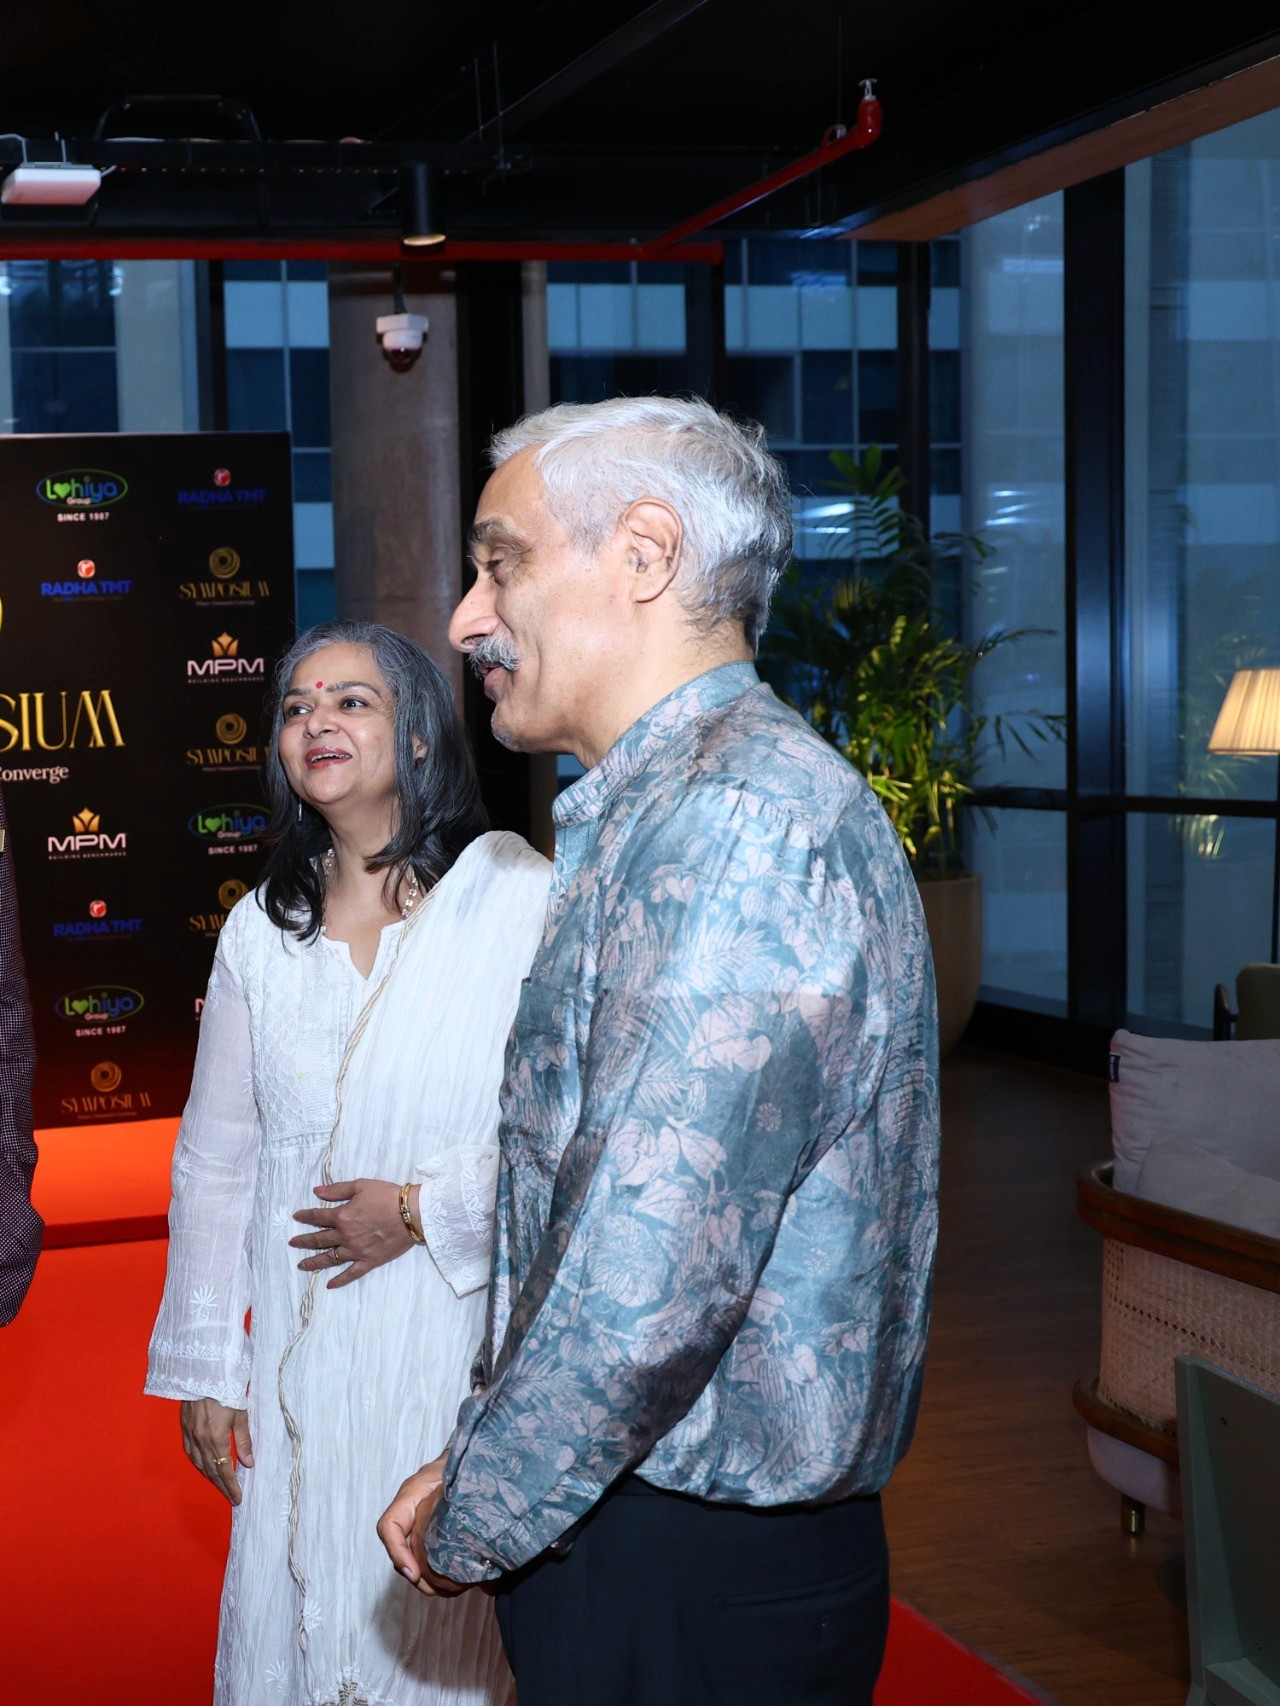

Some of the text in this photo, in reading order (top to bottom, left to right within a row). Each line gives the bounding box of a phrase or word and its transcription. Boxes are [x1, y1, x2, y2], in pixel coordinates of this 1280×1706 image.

[177, 489, 266, 503] RADHA TMT
[57, 512, 110, 522] SINCE 1987
[41, 580, 132, 596] RADHA TMT
[187, 658, 264, 676] MPM
[47, 833, 126, 852] MPM
[208, 846, 235, 855] SINCE
[53, 918, 143, 936] RADHA TMT
[75, 1027, 103, 1037] SINCE
